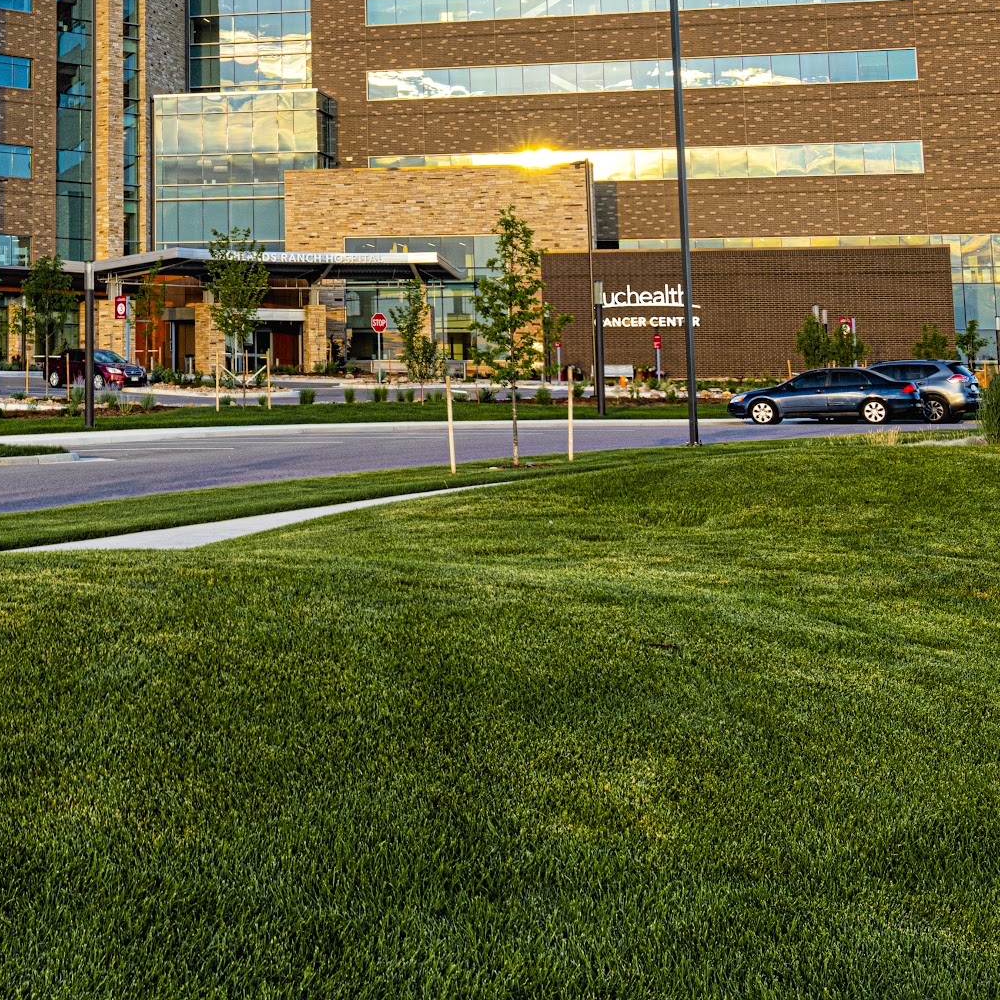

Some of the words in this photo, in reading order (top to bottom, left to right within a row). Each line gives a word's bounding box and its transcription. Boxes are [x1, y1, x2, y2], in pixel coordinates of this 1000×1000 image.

[281, 253, 321, 263] RANCH
[325, 254, 384, 263] HOSPITAL
[372, 319, 386, 327] STOP
[594, 317, 647, 328] ANCER
[649, 316, 700, 327] CENTR
